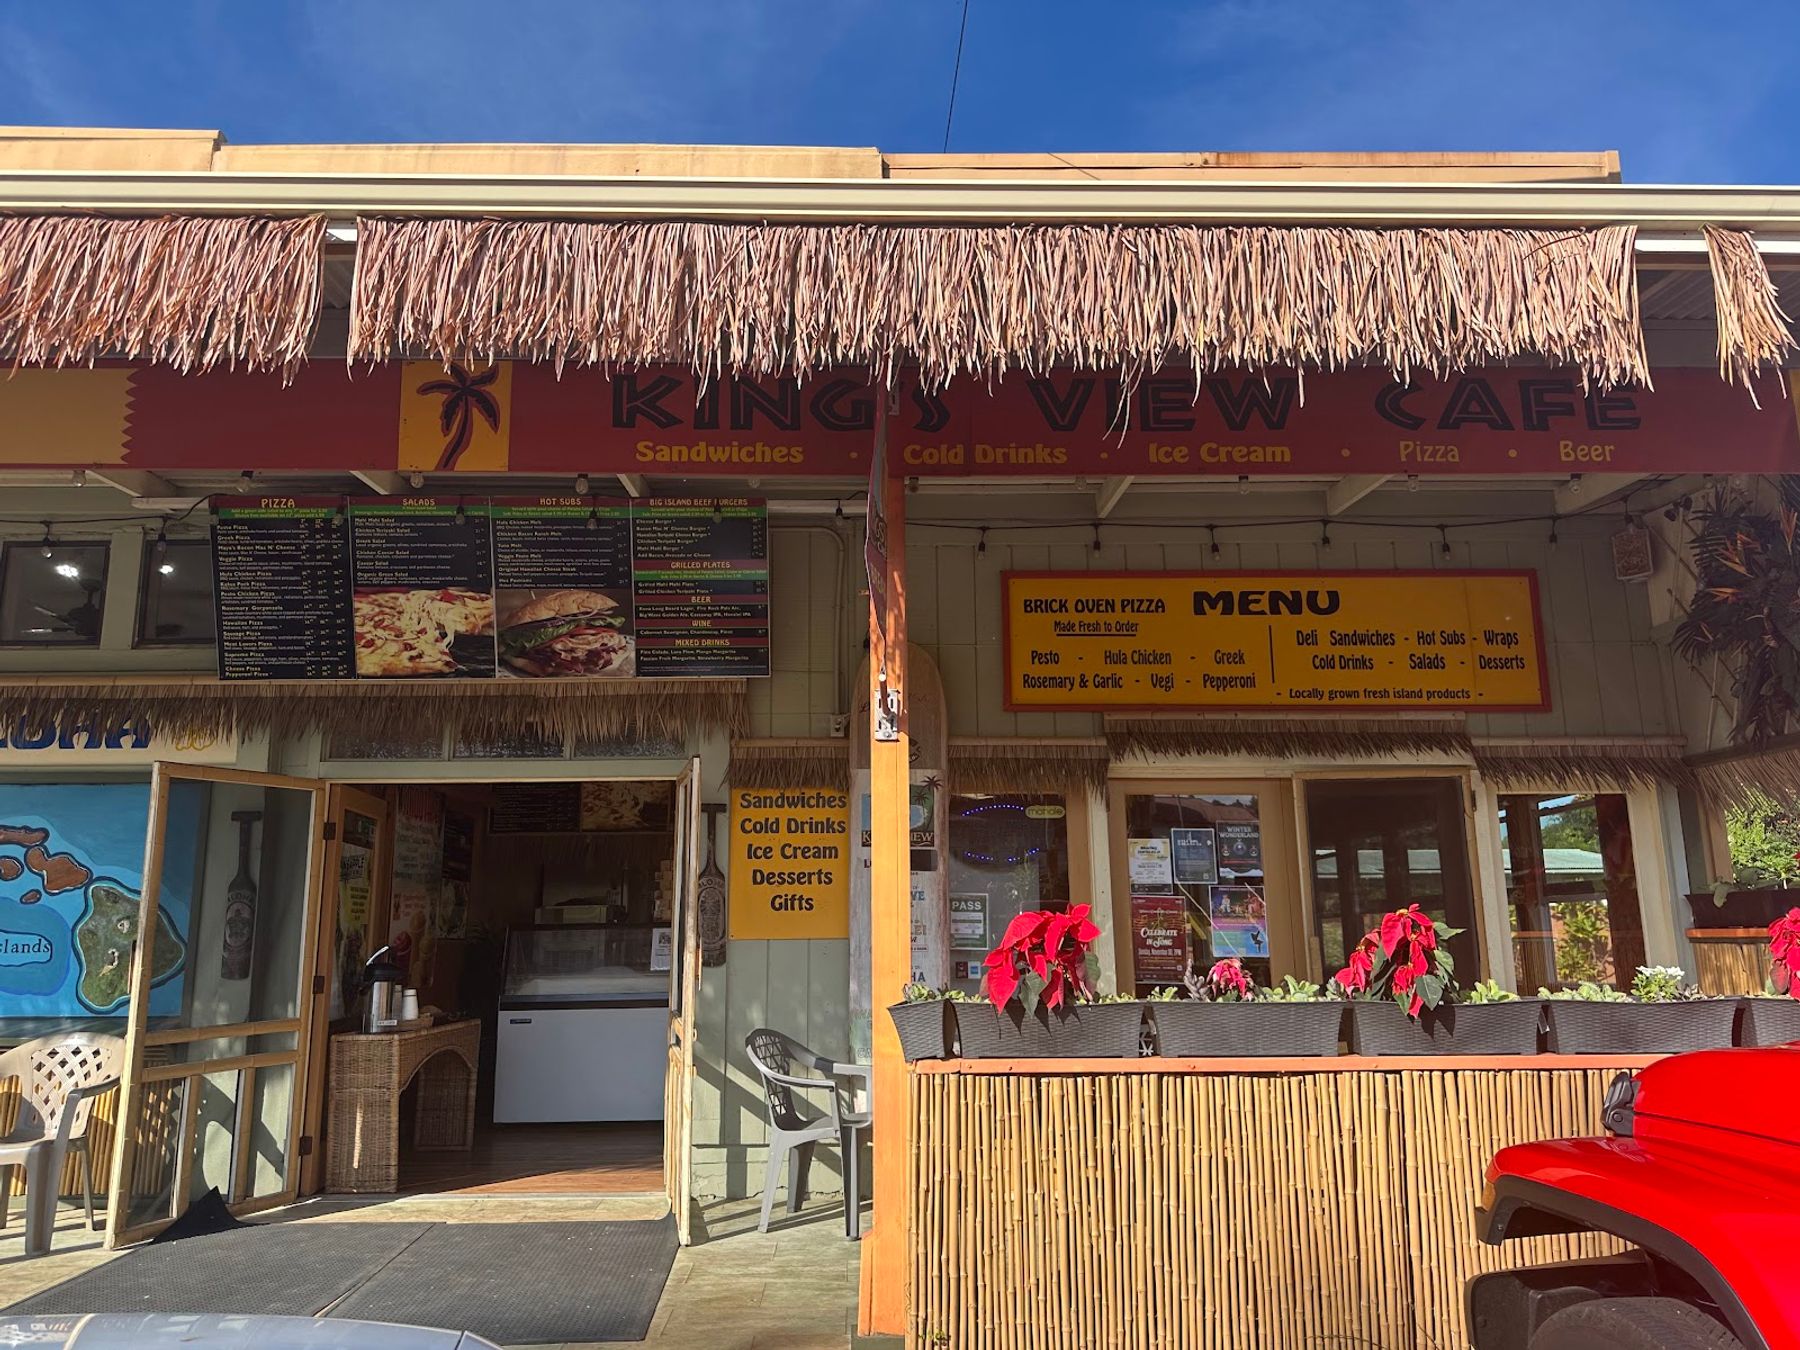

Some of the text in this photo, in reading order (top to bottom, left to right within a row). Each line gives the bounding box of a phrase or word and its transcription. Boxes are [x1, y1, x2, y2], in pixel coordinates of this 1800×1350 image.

[611, 373, 1642, 432] KING'S VIEW CAFE
[635, 441, 1616, 465] Sandwiches Cold Drinks Ice Cream Pizza Beer
[261, 499, 295, 508] PIZZA
[402, 498, 436, 506] SALADS
[540, 498, 582, 506] HOT SUBS
[671, 561, 731, 569] GRILLED PLATES
[1023, 598, 1166, 614] BRICK OVEN PIZZA
[1193, 590, 1341, 616] MENU
[1054, 620, 1139, 634] Made Fresh to Order
[1296, 630, 1518, 648] Deli Sandwiches Hot Subs Wraps
[1031, 649, 1246, 665] Pesto Hula Chicken Greek
[1312, 653, 1524, 670] Cold Drinks Salads Desserts
[1022, 673, 1256, 692] Rosemary & Garlic Vegi Pepperoni
[1289, 688, 1470, 702] Locally grown fresh island products
[740, 792, 847, 809] Sandwiches
[740, 817, 846, 834] Cold Drinks
[910, 832, 934, 841] IEW
[747, 843, 839, 859] Ice Cream
[752, 869, 833, 886] Desserts
[771, 894, 814, 911] Gifts
[952, 901, 982, 910] PASS
